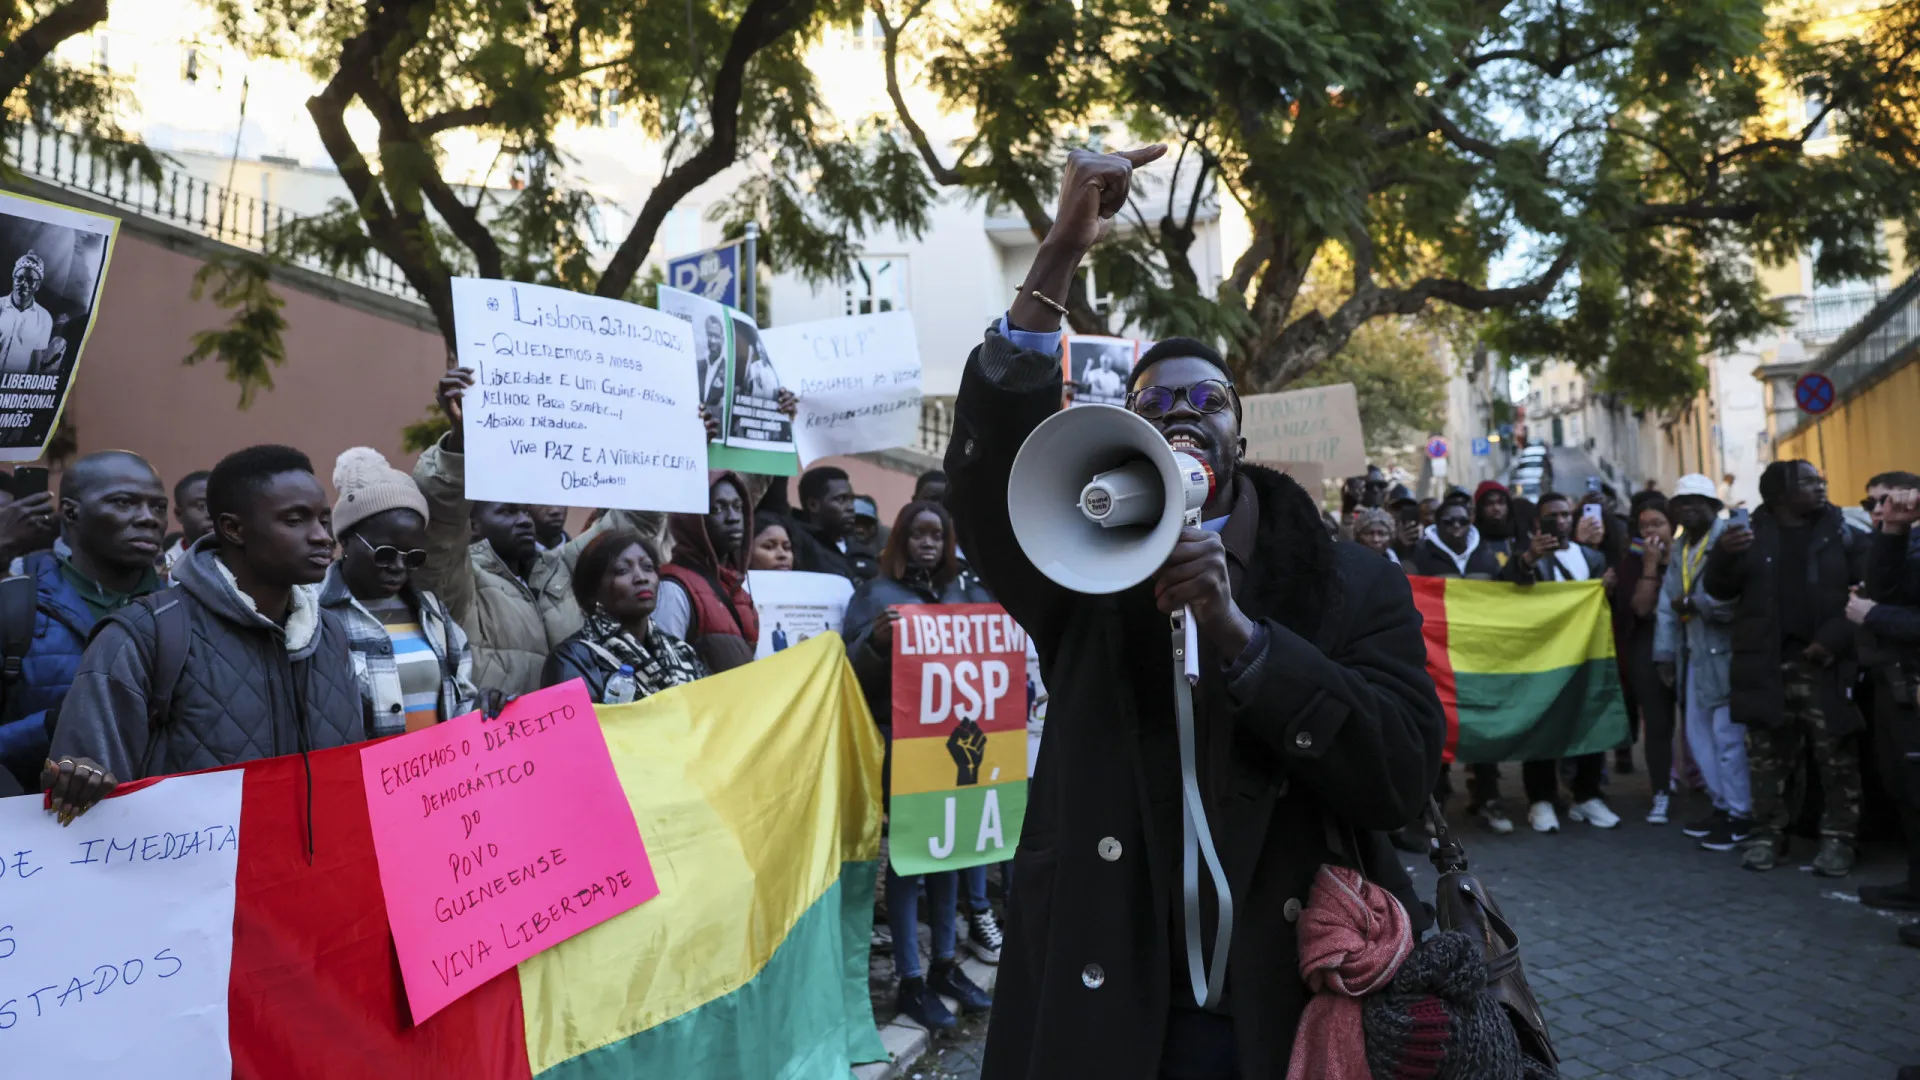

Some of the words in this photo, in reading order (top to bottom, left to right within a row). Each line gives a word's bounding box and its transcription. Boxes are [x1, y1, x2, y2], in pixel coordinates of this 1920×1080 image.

[1, 373, 59, 390] LIBERDADE
[545, 440, 573, 461] PAZ
[582, 447, 592, 463] E
[596, 448, 606, 464] A
[662, 454, 697, 472] CERTA
[1087, 496, 1109, 505] Sound
[1091, 502, 1108, 511] Tech
[901, 613, 1026, 656] LIBERTEM
[919, 659, 1010, 725] DSP
[380, 747, 456, 796] EXIGIMOS
[462, 739, 470, 756] O
[484, 704, 576, 752] DIREITO
[421, 760, 535, 818] DEMOCRÁTICO
[70, 825, 237, 865] IMEDIATA
[460, 809, 481, 839] DO
[449, 842, 499, 884] POVO
[434, 848, 567, 923] GUINEENSE
[432, 938, 492, 987] VIVA
[500, 869, 632, 950] LIBERDADE
